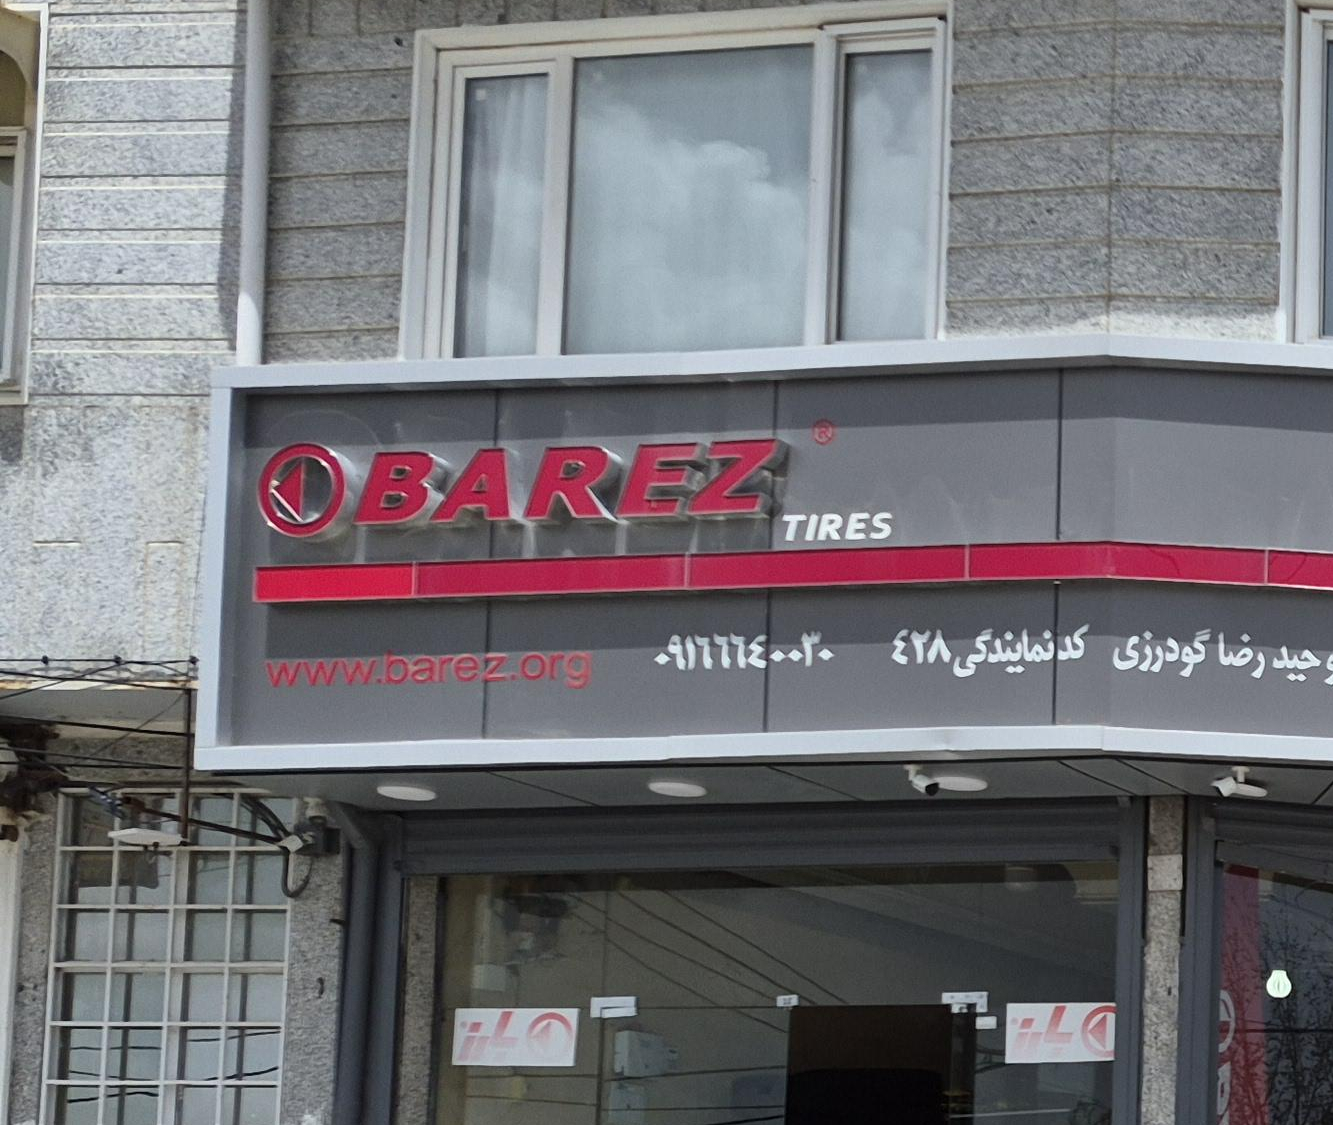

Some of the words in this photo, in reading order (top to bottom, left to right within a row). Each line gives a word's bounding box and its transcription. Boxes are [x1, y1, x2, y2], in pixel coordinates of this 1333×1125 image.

[354, 439, 784, 525] BAREZ
[781, 511, 894, 542] TIRES
[266, 651, 593, 690] www.barez.org
[1112, 629, 1212, 678] گودرزی
[1217, 633, 1267, 679] رضا
